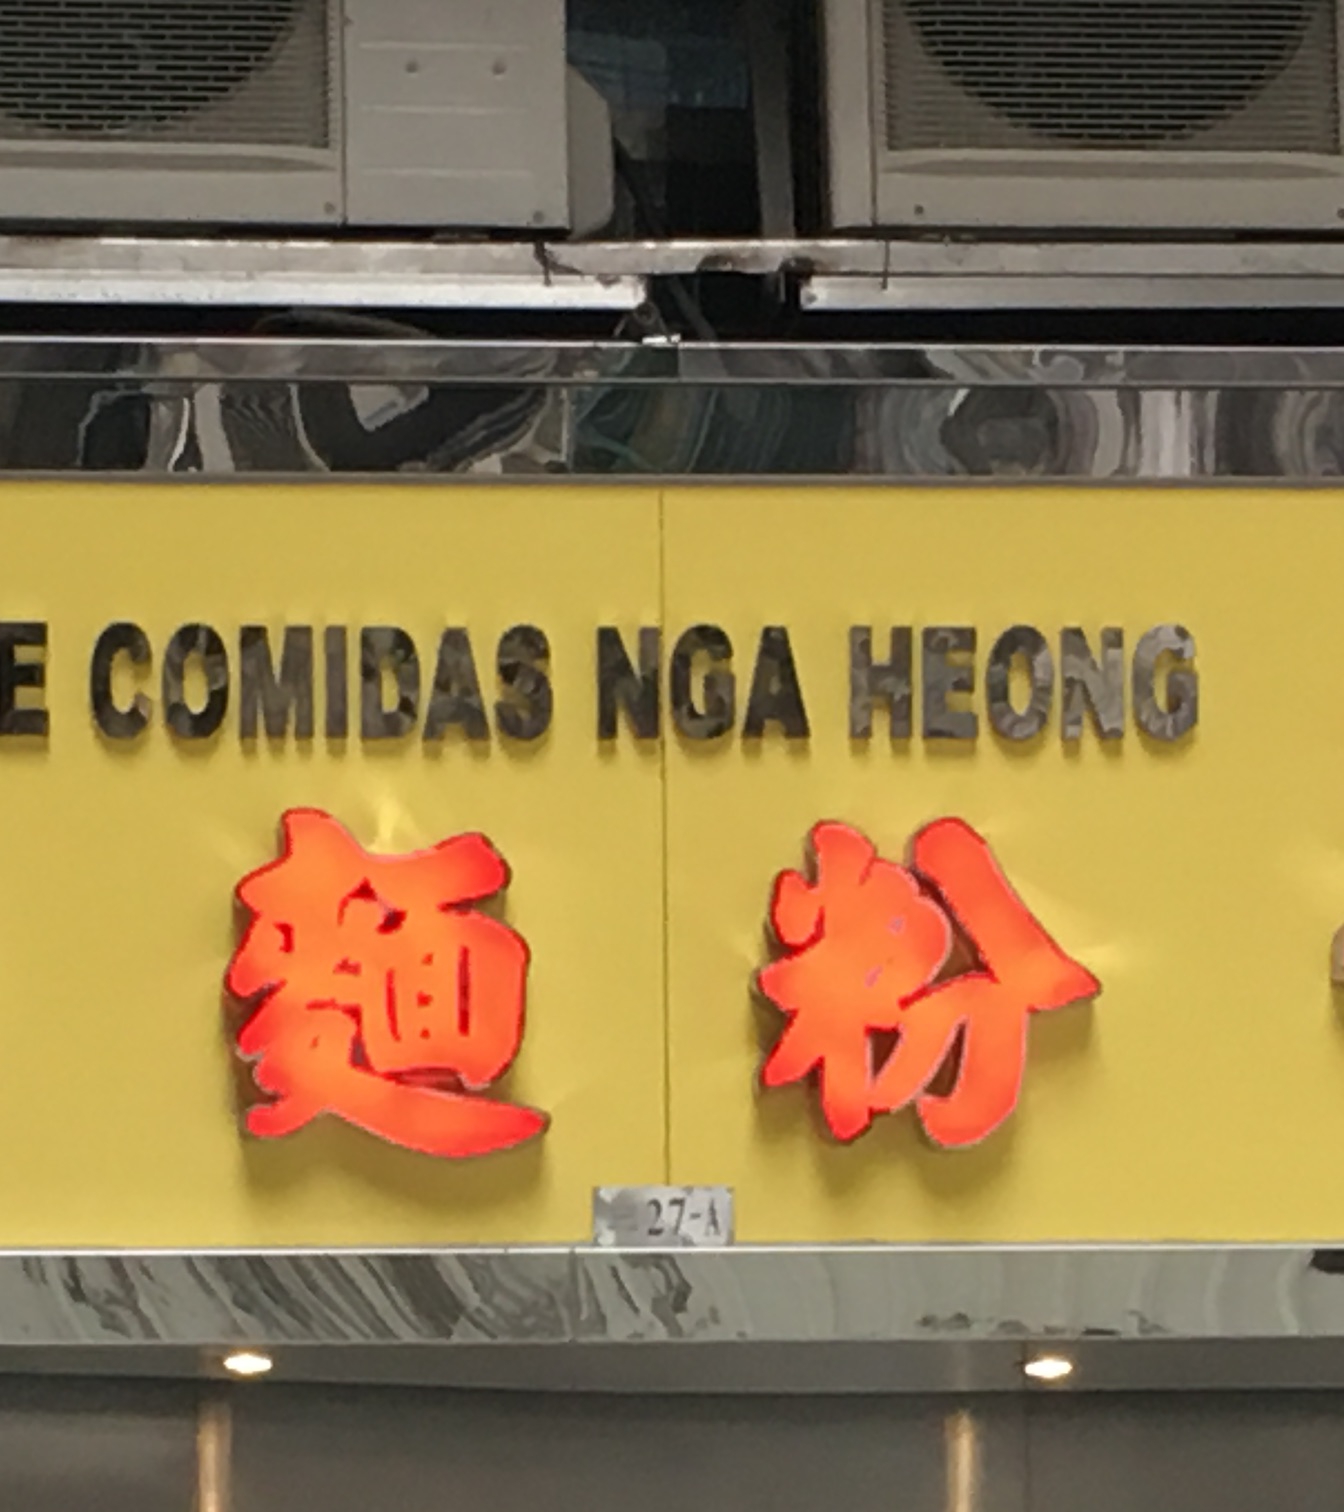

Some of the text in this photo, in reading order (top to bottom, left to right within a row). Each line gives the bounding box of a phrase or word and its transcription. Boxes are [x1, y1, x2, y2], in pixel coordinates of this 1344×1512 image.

[89, 622, 554, 742] COMIDAS
[595, 624, 812, 742] NGA
[849, 624, 1199, 744] HEONG
